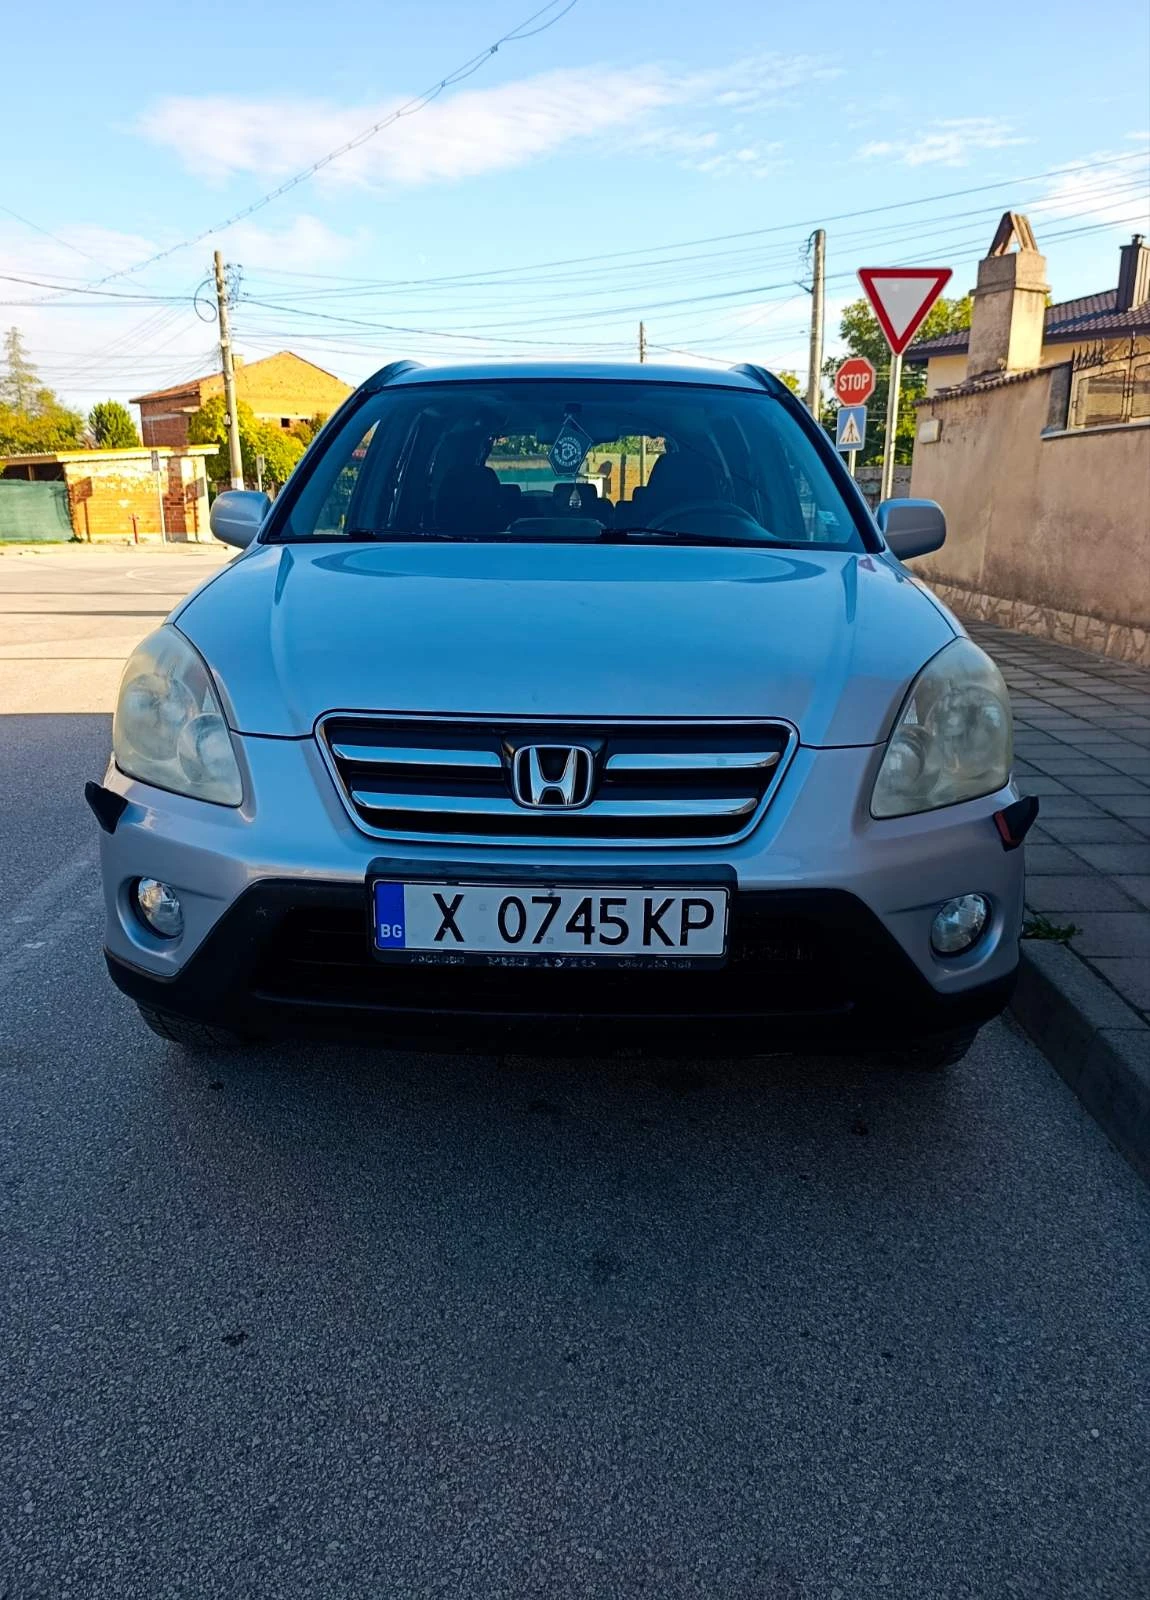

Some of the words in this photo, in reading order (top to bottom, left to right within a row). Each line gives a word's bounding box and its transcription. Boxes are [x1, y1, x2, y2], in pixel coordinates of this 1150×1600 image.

[839, 372, 870, 392] STOP
[433, 893, 465, 943] X
[497, 896, 629, 945] 0745
[642, 897, 715, 946] KP
[380, 923, 403, 938] BG
